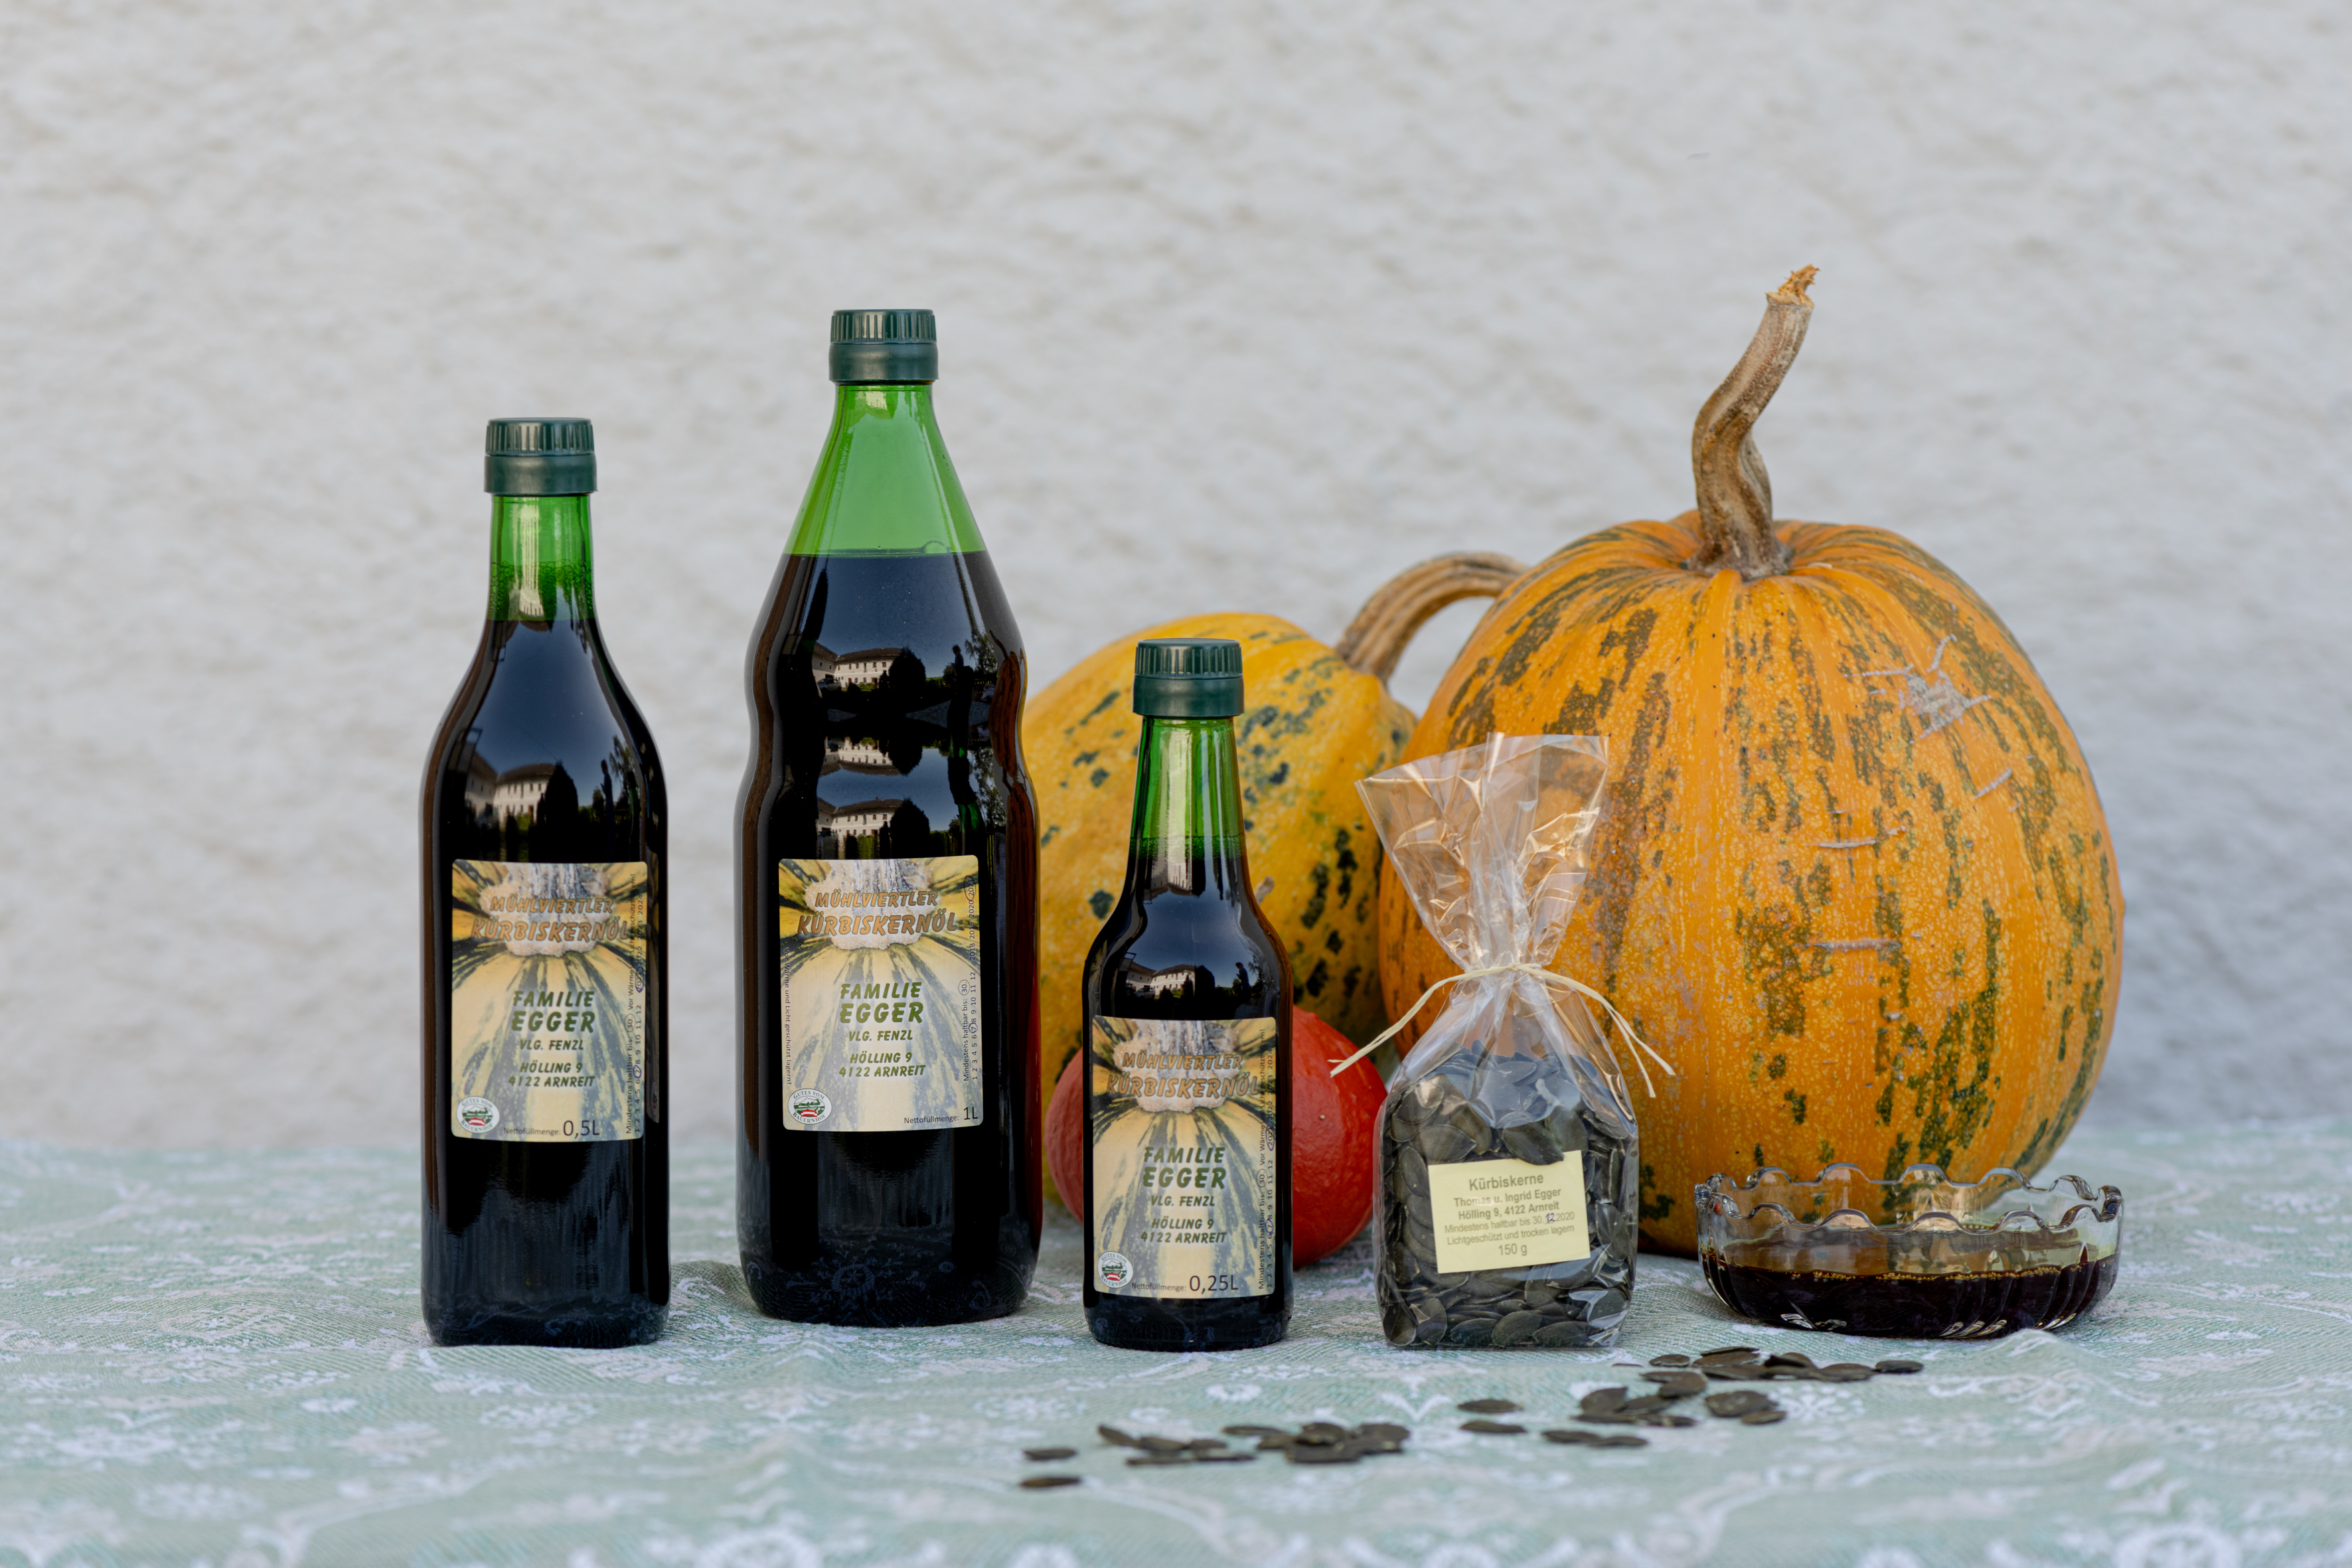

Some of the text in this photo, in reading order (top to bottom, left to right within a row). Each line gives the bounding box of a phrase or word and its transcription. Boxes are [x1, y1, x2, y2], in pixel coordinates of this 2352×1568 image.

[490, 894, 614, 913] MÜHLVIERTLER
[815, 889, 938, 908] MÜHLVIERTLER
[471, 915, 629, 942] KÜRBISKERNÖL
[797, 909, 957, 936] KÜRBISKERNÖL
[512, 990, 594, 1007] FAMILIE
[840, 981, 922, 1000] FAMILIE
[839, 1001, 923, 1024] EGGER
[511, 1011, 595, 1033] EGGER
[848, 1030, 913, 1042] VLG. FENZL
[520, 1040, 584, 1051] VLG. FENZL
[849, 1050, 913, 1064] HÖLLING 9
[1123, 1050, 1243, 1070] MÜHLVIERTLER
[520, 1060, 583, 1073] HÖLLING 9
[838, 1065, 926, 1077] 4122 ARNREIT
[508, 1076, 595, 1087] 4122 ARNREIT
[1107, 1071, 1260, 1099] KÜRBISKERNÖL
[462, 1098, 493, 1109] GUTES VOM
[793, 1090, 825, 1100] GUTES VOM
[793, 1111, 826, 1124] BAUERNHOF
[903, 1107, 979, 1124] Nettofüllmenge: 1L
[461, 1119, 493, 1133] BAUERNHOF
[504, 1120, 600, 1139] Nettofüllmenge: 0,5L
[1144, 1146, 1225, 1163] FAMILIE
[1142, 1167, 1227, 1190] EGGER
[1469, 1174, 1543, 1191] Kürbiskerne
[1150, 1196, 1215, 1207] VLG. FENZL
[1454, 1196, 1491, 1207] Thomas
[1505, 1190, 1531, 1204] Ingrid
[1535, 1188, 1561, 1200] Egger
[1458, 1201, 1559, 1221] Hölling 9, 4122 Arnreit
[1151, 1215, 1214, 1229] HÖLLING 9
[1445, 1221, 1489, 1233] Mindestens
[1491, 1217, 1518, 1229] haltbar
[1520, 1217, 1531, 1226] bis
[1140, 1232, 1227, 1244] 4122 ARNREIT
[1447, 1224, 1575, 1245] Lichtgeschützt und trocken lagern
[1498, 1243, 1528, 1256] 150 g
[1117, 1254, 1127, 1264] VOM
[1101, 1274, 1128, 1287] BAUERNHOF
[1131, 1275, 1238, 1294] Nettofüllmenge: 0,25L
